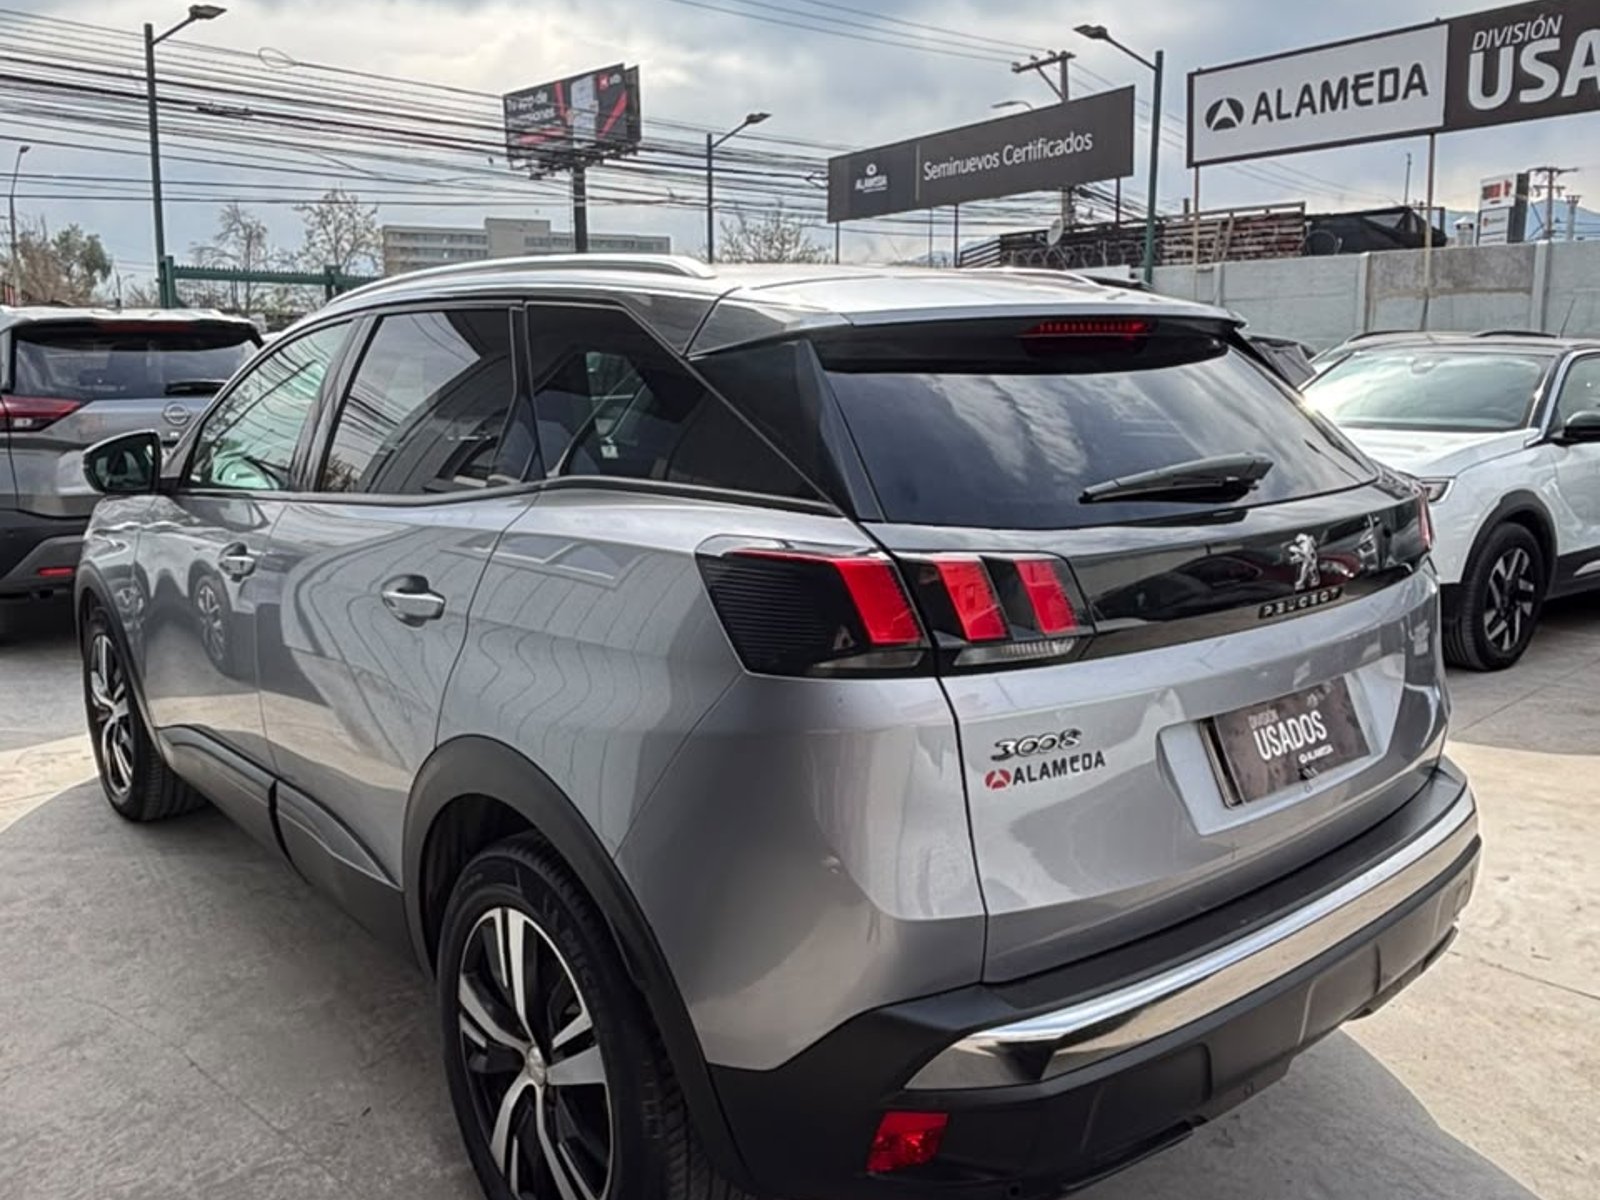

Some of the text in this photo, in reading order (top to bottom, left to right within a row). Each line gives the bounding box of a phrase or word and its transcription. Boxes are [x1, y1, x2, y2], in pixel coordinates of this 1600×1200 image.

[1472, 13, 1563, 51] DIVISIÓN
[1252, 63, 1428, 126] ALAMEDA
[923, 131, 1093, 182] Seminuevos Certificados
[1262, 587, 1340, 617] PEUGEOT
[990, 727, 1082, 761] 3008
[1253, 710, 1327, 760] USADOS
[1013, 750, 1106, 785] ALAMEDA
